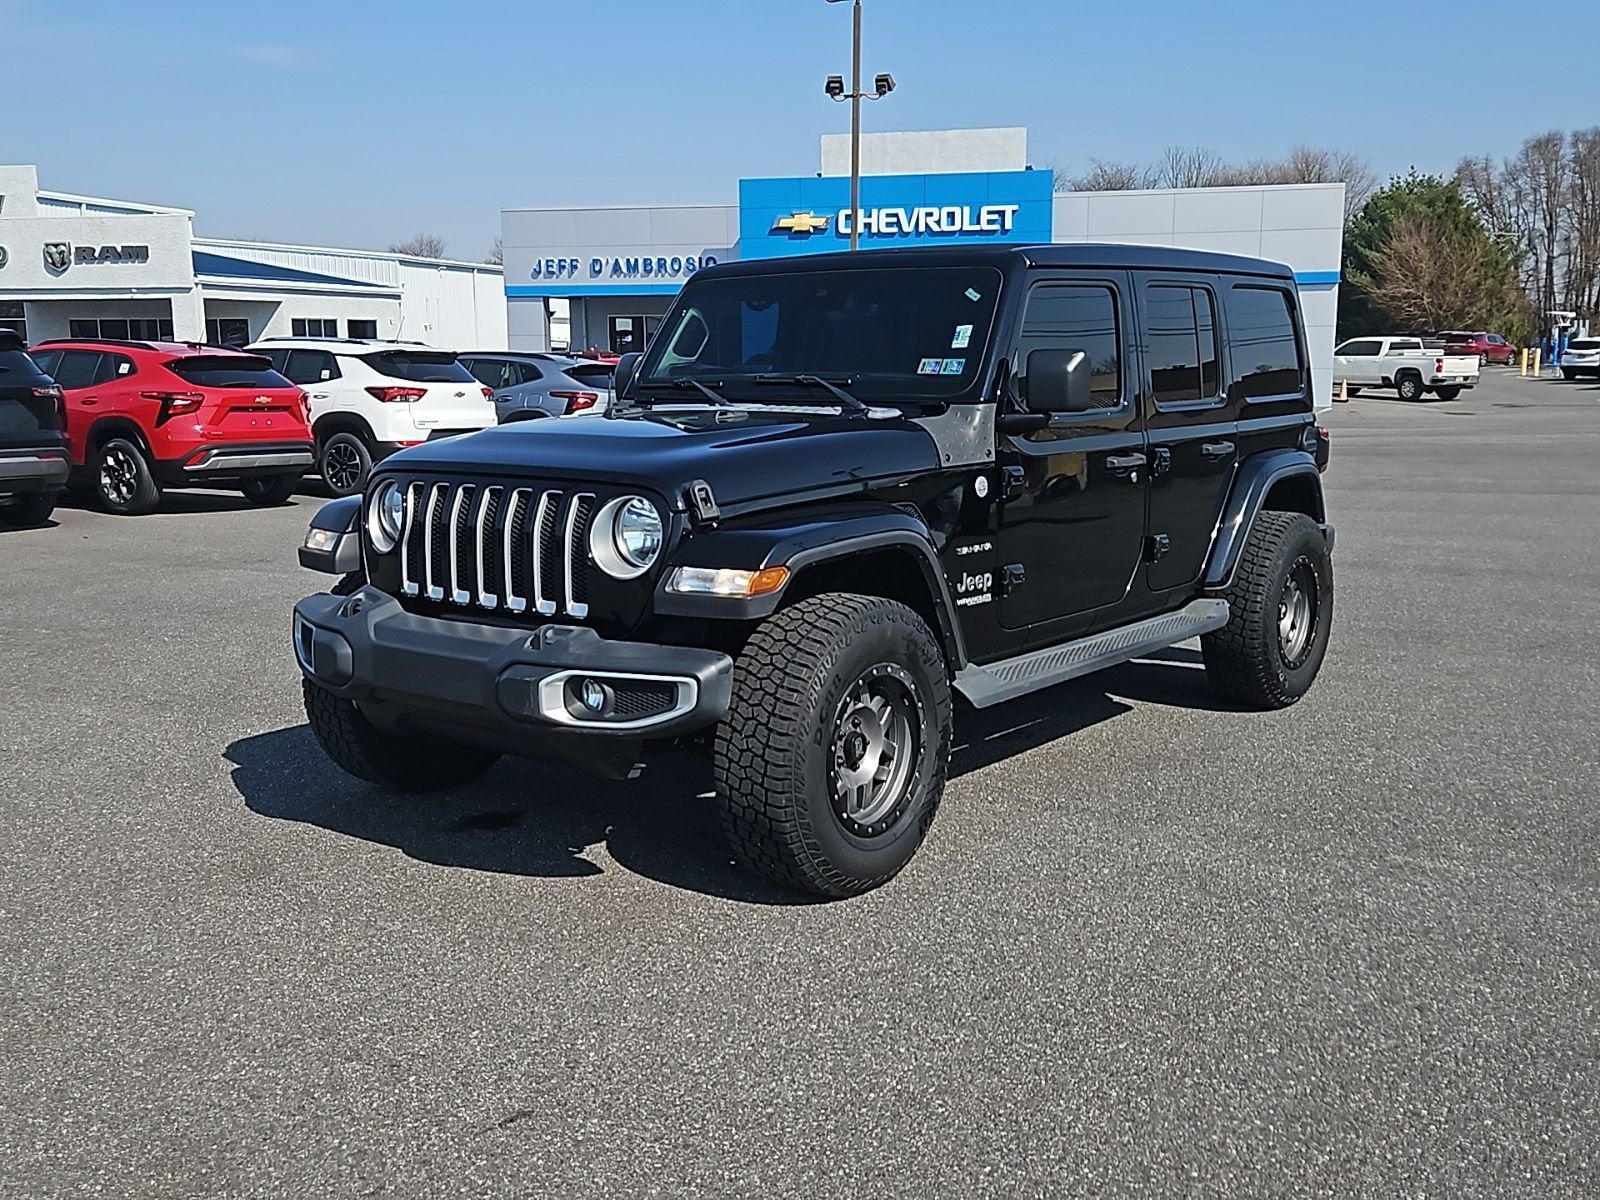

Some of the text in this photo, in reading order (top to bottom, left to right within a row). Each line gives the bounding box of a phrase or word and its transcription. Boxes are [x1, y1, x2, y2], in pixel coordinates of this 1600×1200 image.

[837, 204, 1019, 235] CHEVROLET
[74, 246, 149, 263] RAM
[532, 256, 718, 276] JEFF D'AMBROSIO
[956, 572, 993, 593] Jeep
